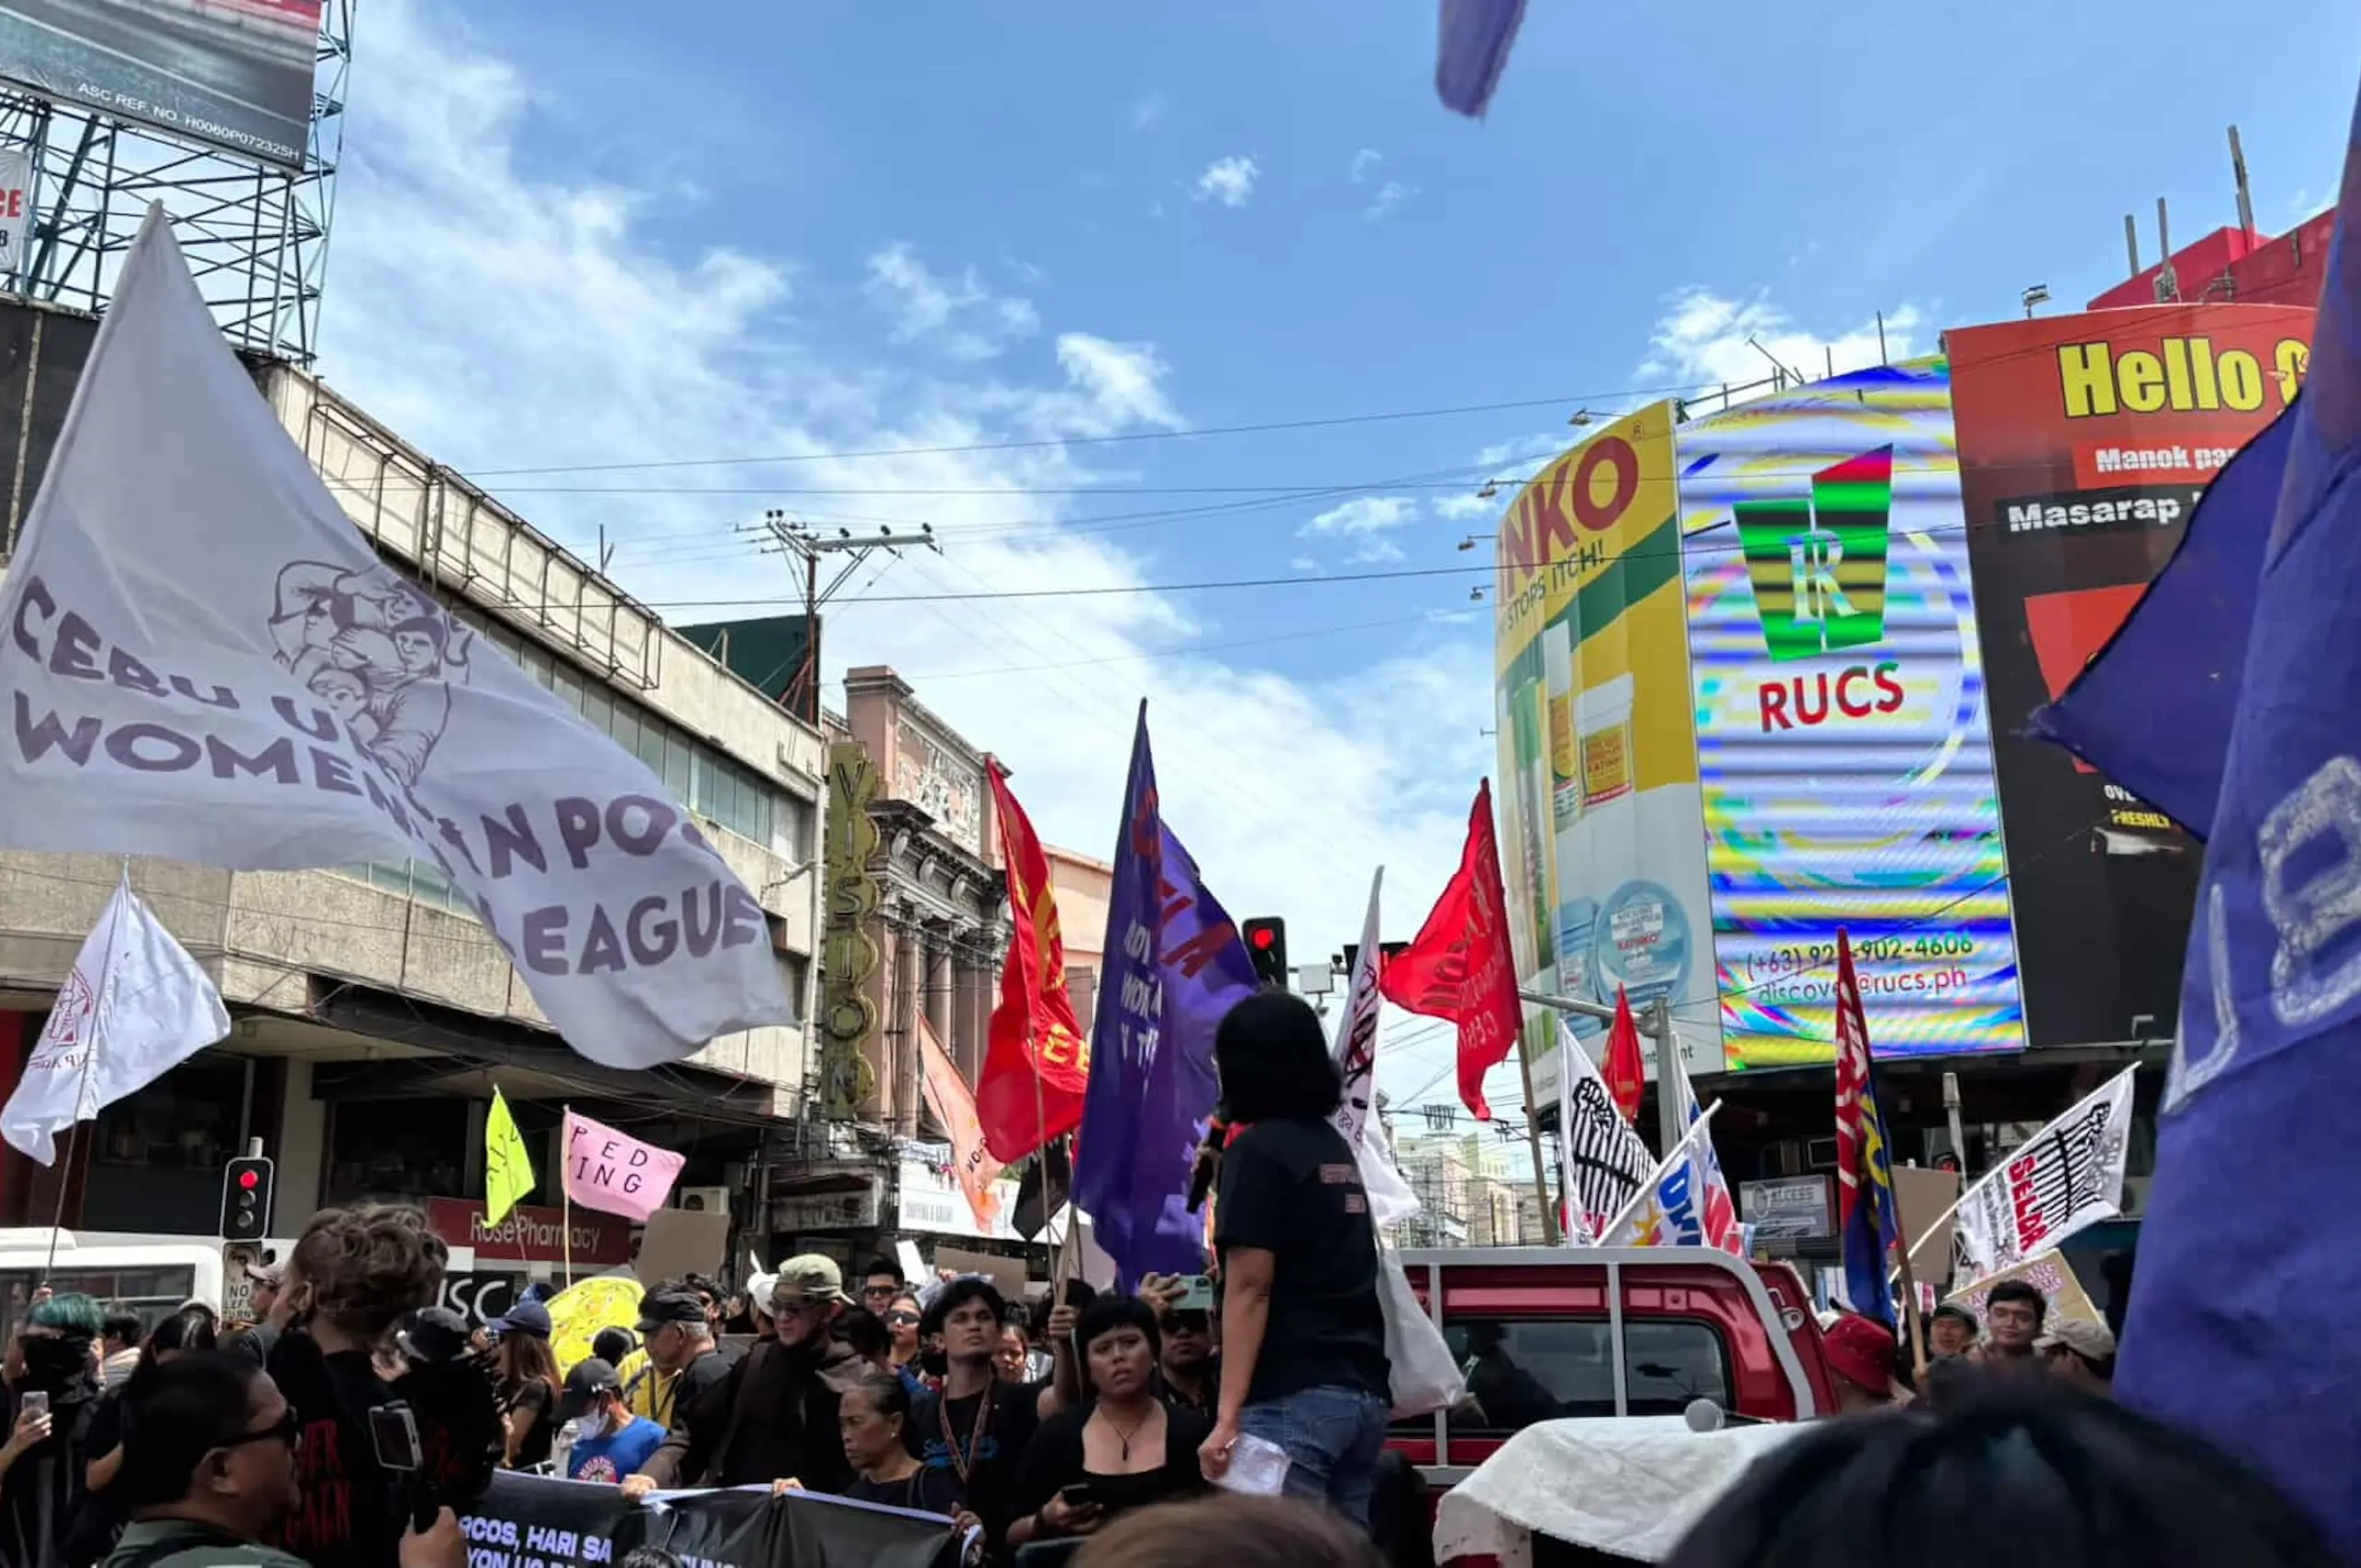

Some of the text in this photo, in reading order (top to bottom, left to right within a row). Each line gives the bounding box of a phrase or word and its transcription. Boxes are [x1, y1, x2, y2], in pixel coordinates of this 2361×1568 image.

[77, 82, 112, 101] ASC
[2056, 336, 2265, 420] Hello
[2094, 445, 2191, 473] Manok
[2008, 497, 2181, 532] Masarap
[1506, 538, 1603, 630] STOPS ITCH!
[1759, 660, 1904, 734] RUCS
[1809, 930, 1974, 966] 92-902-4606
[1758, 966, 1967, 1004] discove@rucs.ph
[567, 1155, 643, 1194] ING
[2008, 1155, 2048, 1253] SELDA
[229, 1285, 249, 1299] NO
[459, 1515, 520, 1553] RCOS,
[527, 1525, 578, 1559] HARI
[581, 1535, 613, 1564] SA
